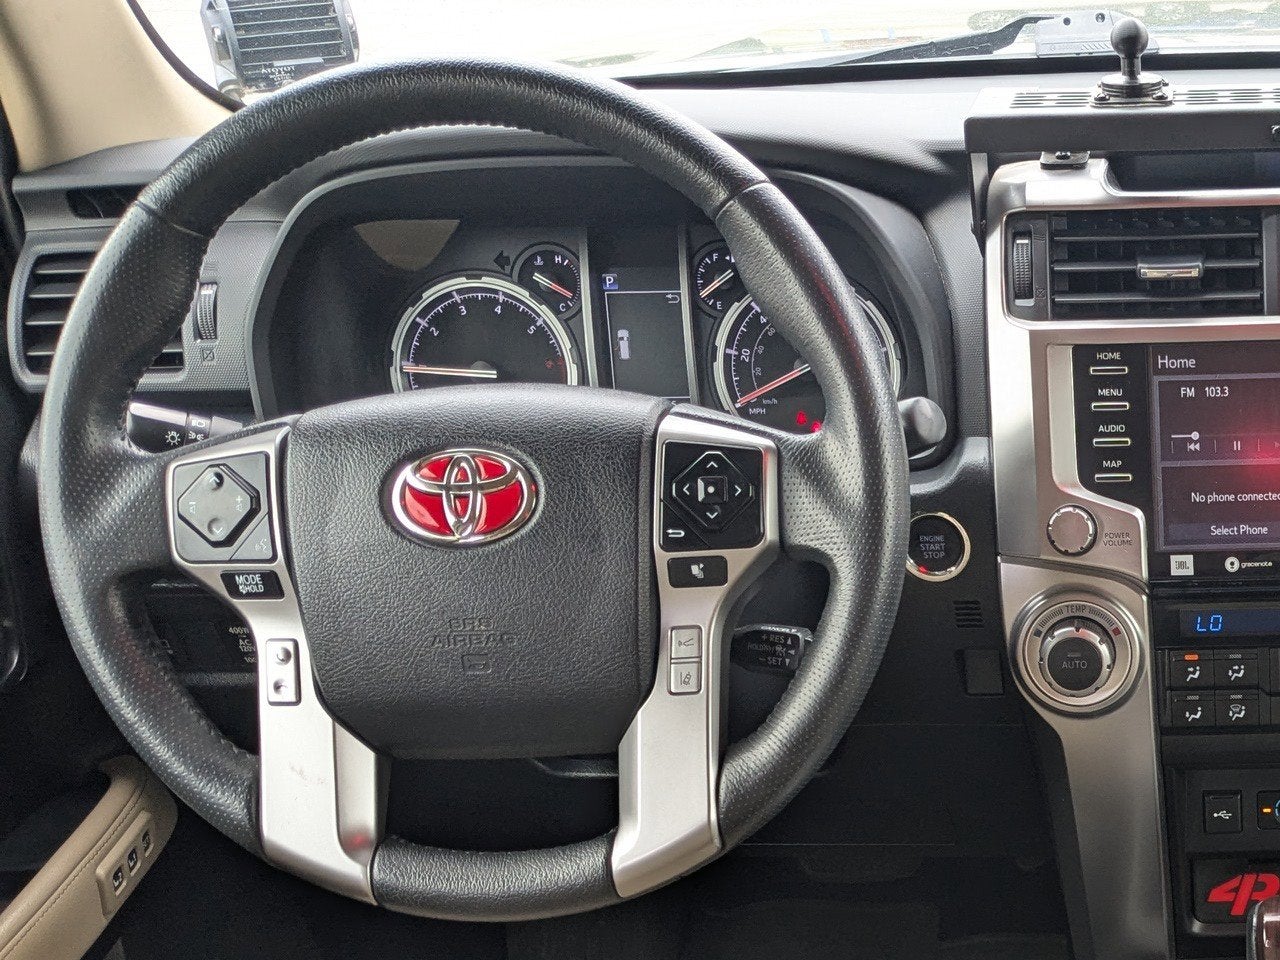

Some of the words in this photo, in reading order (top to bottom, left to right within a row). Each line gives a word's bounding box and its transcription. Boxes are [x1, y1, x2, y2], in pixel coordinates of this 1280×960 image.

[554, 255, 562, 264] H
[712, 253, 719, 262] F
[606, 277, 614, 287] P
[494, 305, 502, 315] 4
[559, 303, 566, 312] C
[716, 301, 722, 310] E
[458, 305, 467, 316] 3
[429, 327, 439, 337] 2
[527, 325, 536, 335] 5
[740, 348, 751, 363] 20
[1096, 352, 1121, 360] HOME
[1157, 355, 1196, 369] Home
[1098, 388, 1123, 396] MENU
[1180, 387, 1195, 398] FM
[1204, 386, 1229, 398] 103.3
[1098, 424, 1126, 432] AUDIO
[1102, 460, 1122, 468] MAP
[1191, 492, 1205, 503] No
[1207, 491, 1238, 505] phone
[1210, 525, 1238, 535] Select
[1240, 524, 1268, 535] Phone
[1104, 532, 1130, 540] POWER
[1103, 539, 1133, 547] VOLUME
[923, 551, 945, 559] STOP
[1241, 561, 1273, 569] gracenote
[235, 574, 262, 585] MODE
[244, 584, 264, 593] HOLD
[1065, 605, 1087, 614] TEMP
[1196, 614, 1223, 632] LO
[1062, 661, 1088, 669] AUTO
